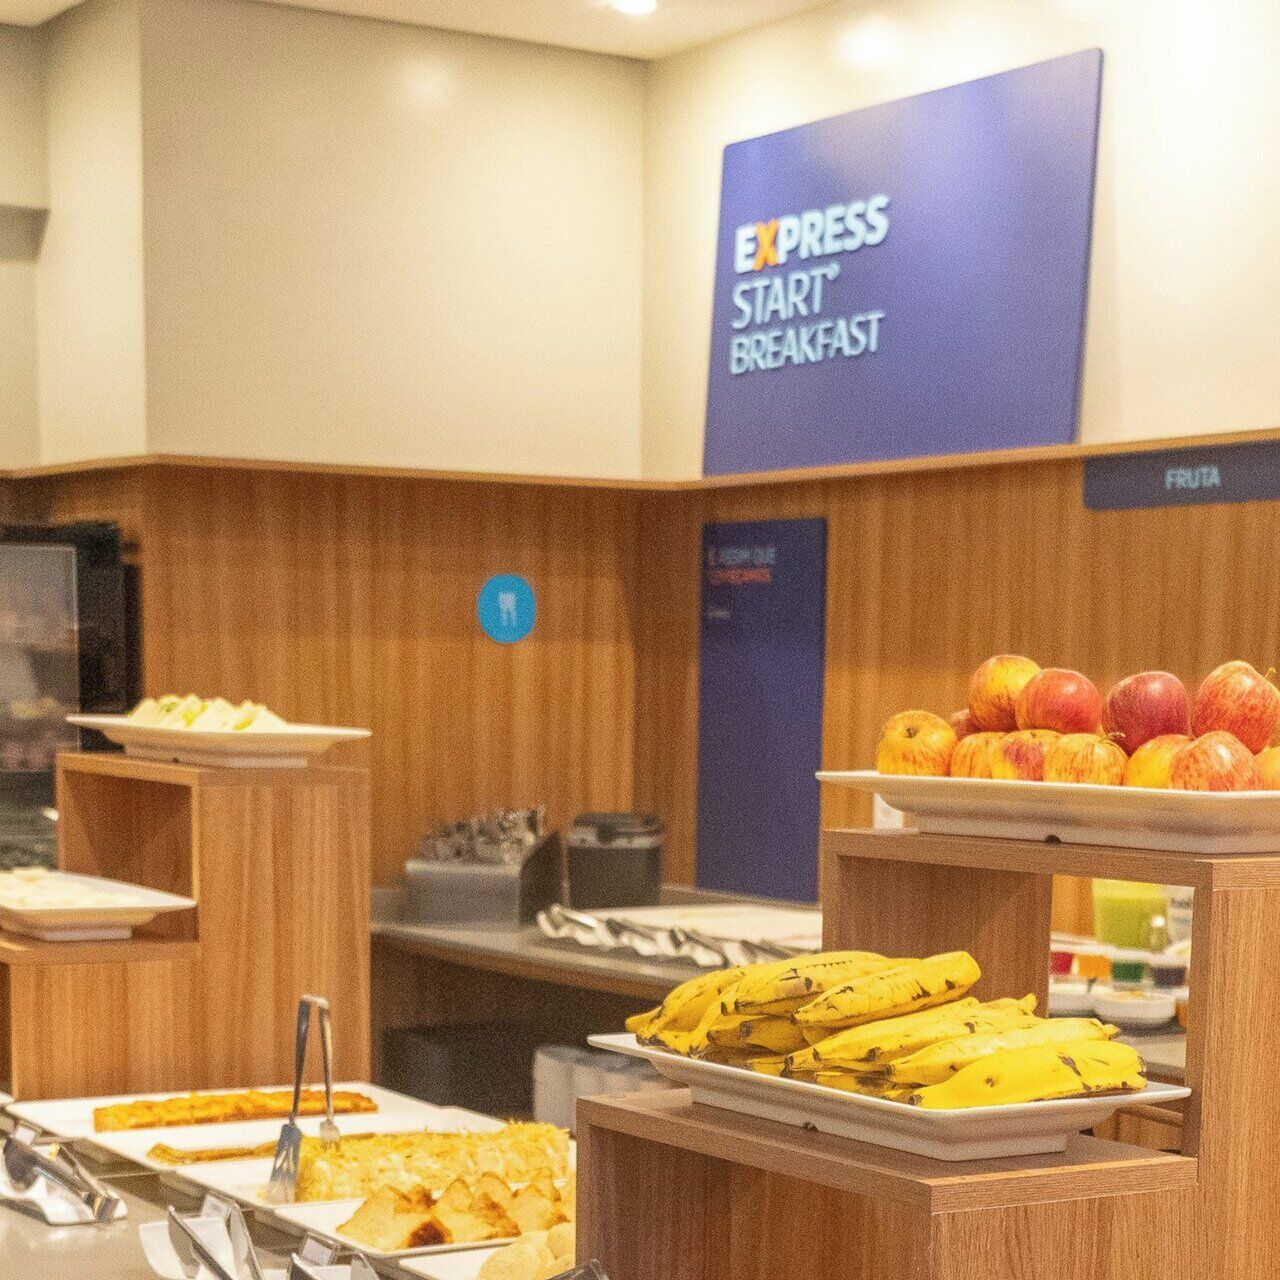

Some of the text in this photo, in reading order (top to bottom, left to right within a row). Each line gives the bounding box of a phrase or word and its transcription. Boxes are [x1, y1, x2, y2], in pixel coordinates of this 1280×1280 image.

[735, 195, 890, 273] EXPRESS
[731, 311, 885, 375] BREAKFAST
[1166, 466, 1220, 489] FRUTA
